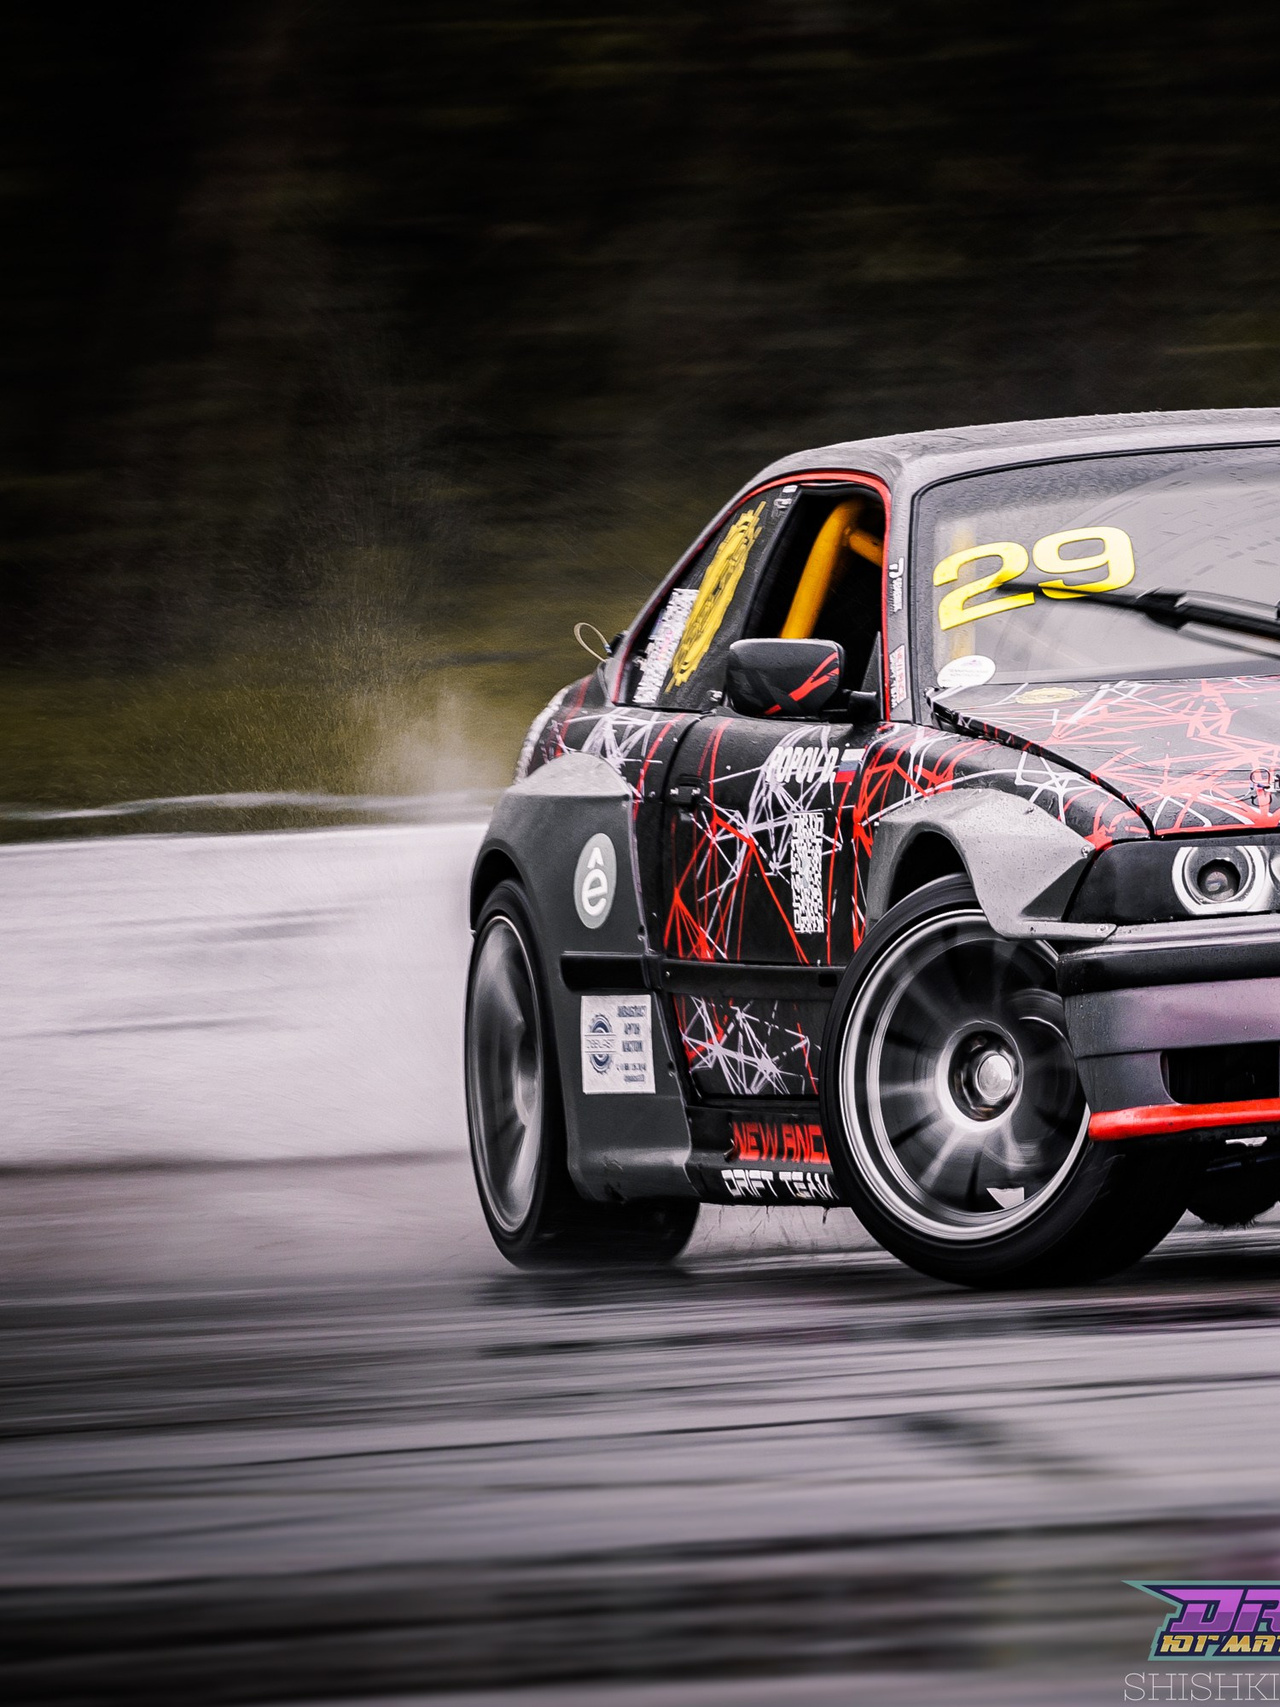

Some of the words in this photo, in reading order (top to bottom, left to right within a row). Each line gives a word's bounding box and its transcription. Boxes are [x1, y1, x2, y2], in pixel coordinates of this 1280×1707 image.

[933, 526, 1136, 631] 29
[732, 1121, 778, 1161] NEW
[721, 1169, 778, 1198] DRIFT
[779, 1171, 840, 1199] TEAM
